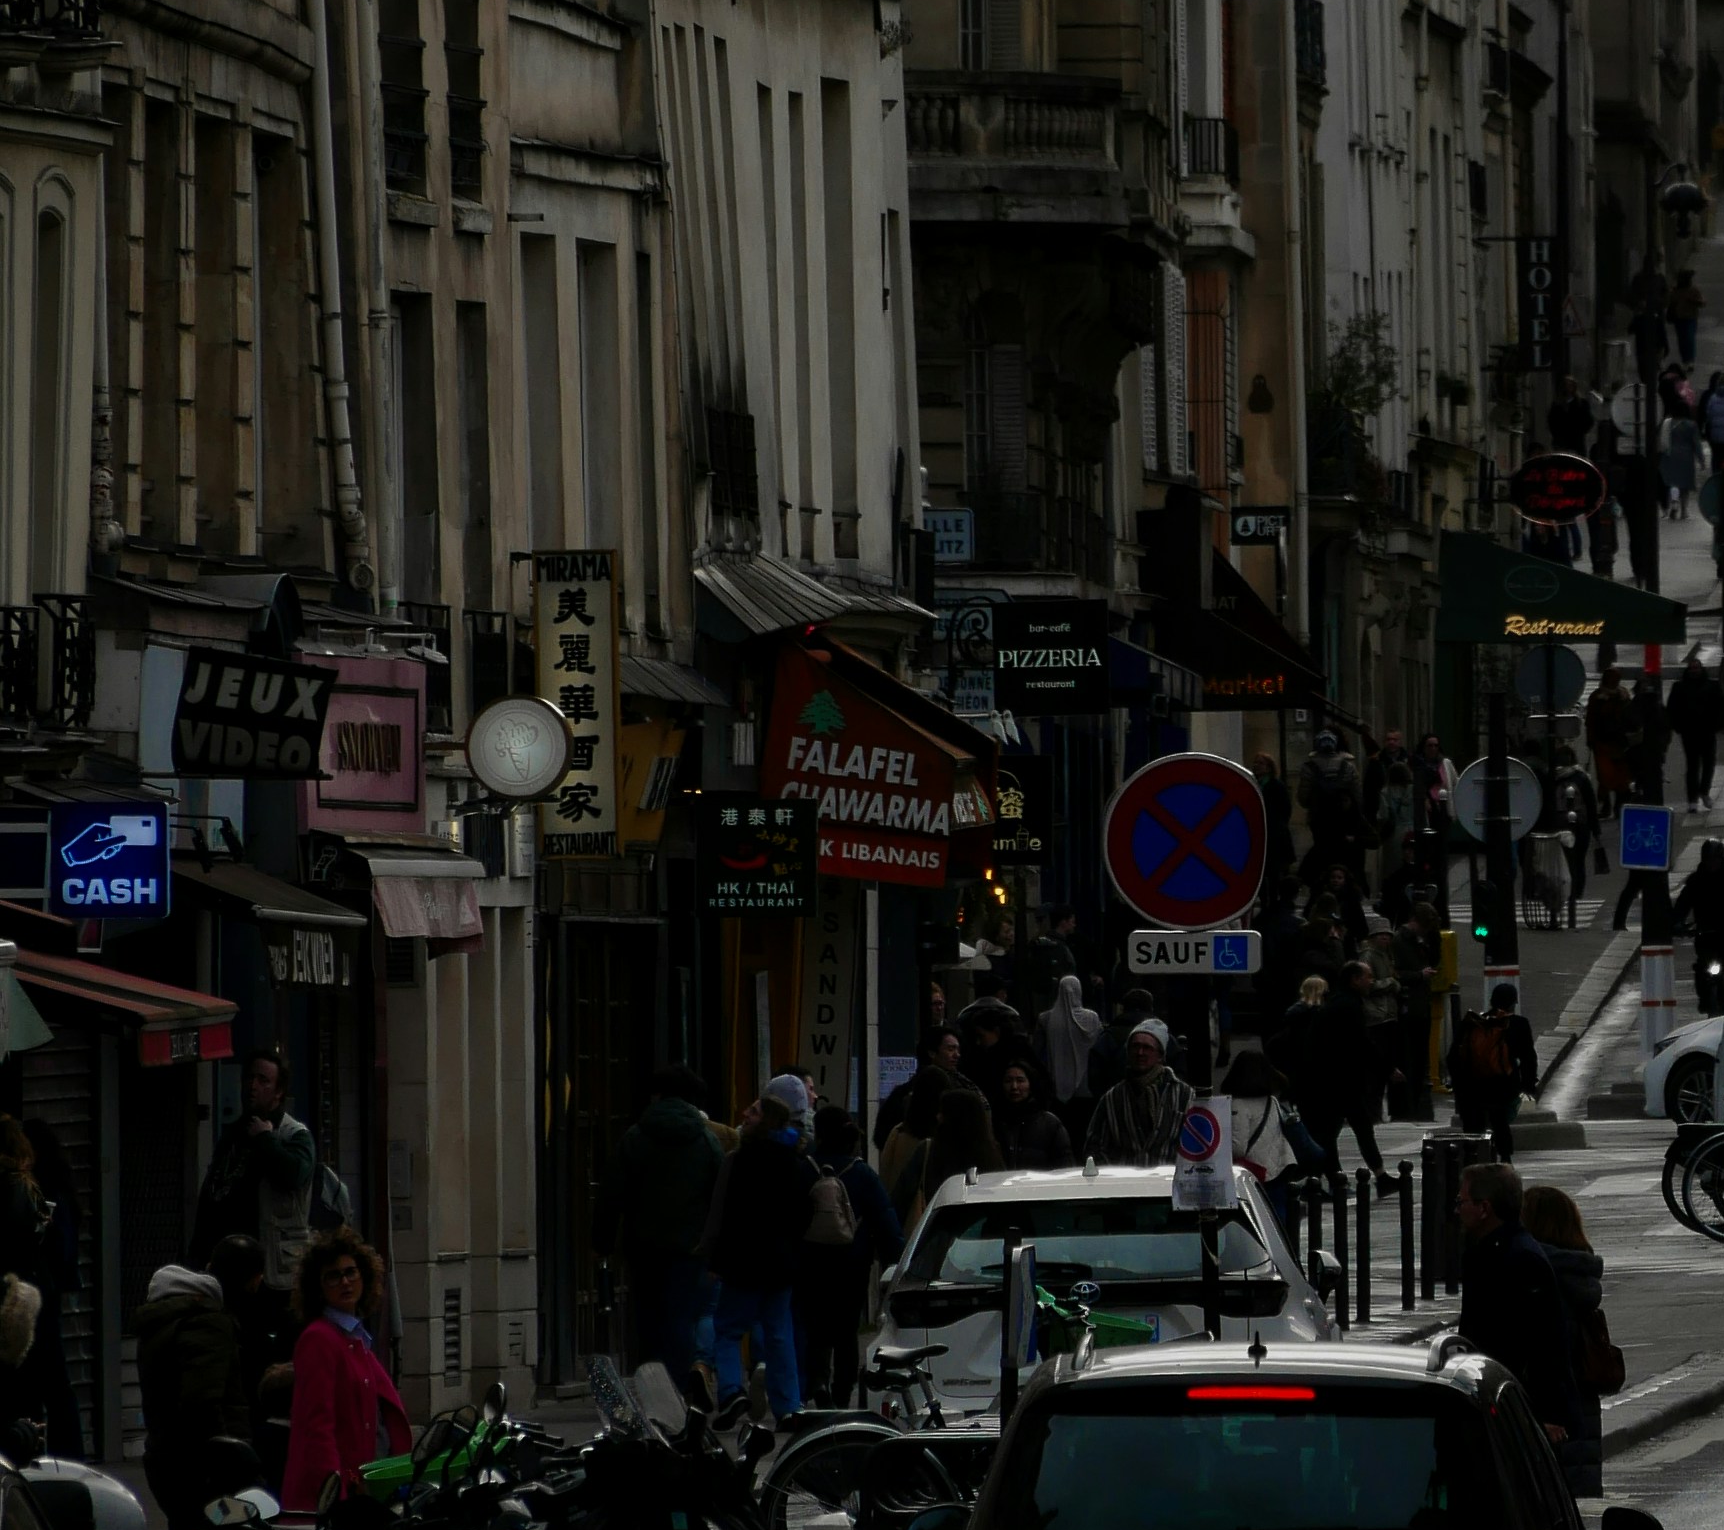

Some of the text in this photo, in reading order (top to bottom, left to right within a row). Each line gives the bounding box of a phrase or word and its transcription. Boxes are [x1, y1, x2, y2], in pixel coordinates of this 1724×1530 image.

[1528, 241, 1552, 367] HOTEL
[536, 555, 611, 582] MIRAMA
[998, 647, 1102, 669] PIZZERIA
[183, 662, 325, 721] JEUX
[178, 718, 312, 773] VIDEO
[787, 736, 919, 787] FALAFEL
[780, 781, 950, 836] CHAWARMA
[544, 832, 616, 855] RESTAURANT
[819, 839, 941, 870] K LIBANAIS
[61, 878, 157, 905] CASH
[717, 882, 741, 894] HK
[755, 880, 795, 894] THAÏ
[708, 898, 804, 908] RESTAURANT
[1136, 941, 1208, 965] SAUF
